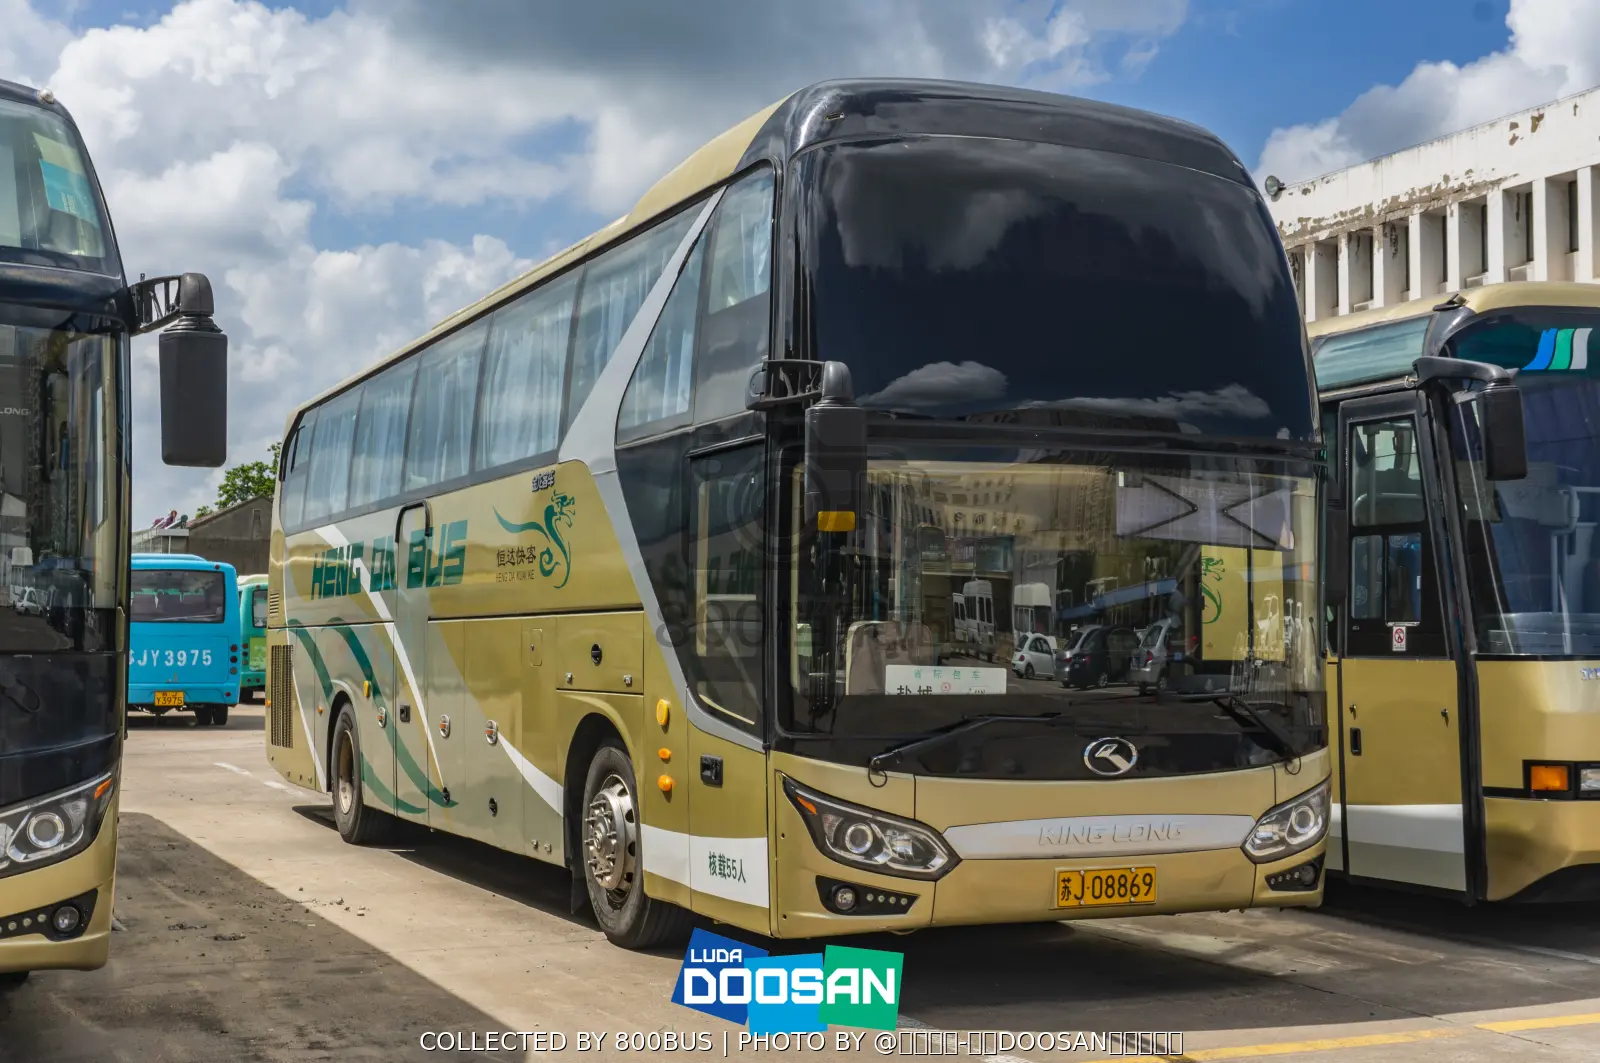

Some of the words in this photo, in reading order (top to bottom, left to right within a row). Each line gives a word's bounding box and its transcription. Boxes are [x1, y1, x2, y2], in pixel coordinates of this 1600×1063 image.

[311, 541, 364, 600] HENG
[370, 535, 398, 592] DA
[407, 520, 468, 588] BUS
[496, 545, 536, 567] 恒达快客
[1039, 825, 1106, 846] KING
[1112, 821, 1187, 843] LONG
[708, 851, 746, 883] 核载55人
